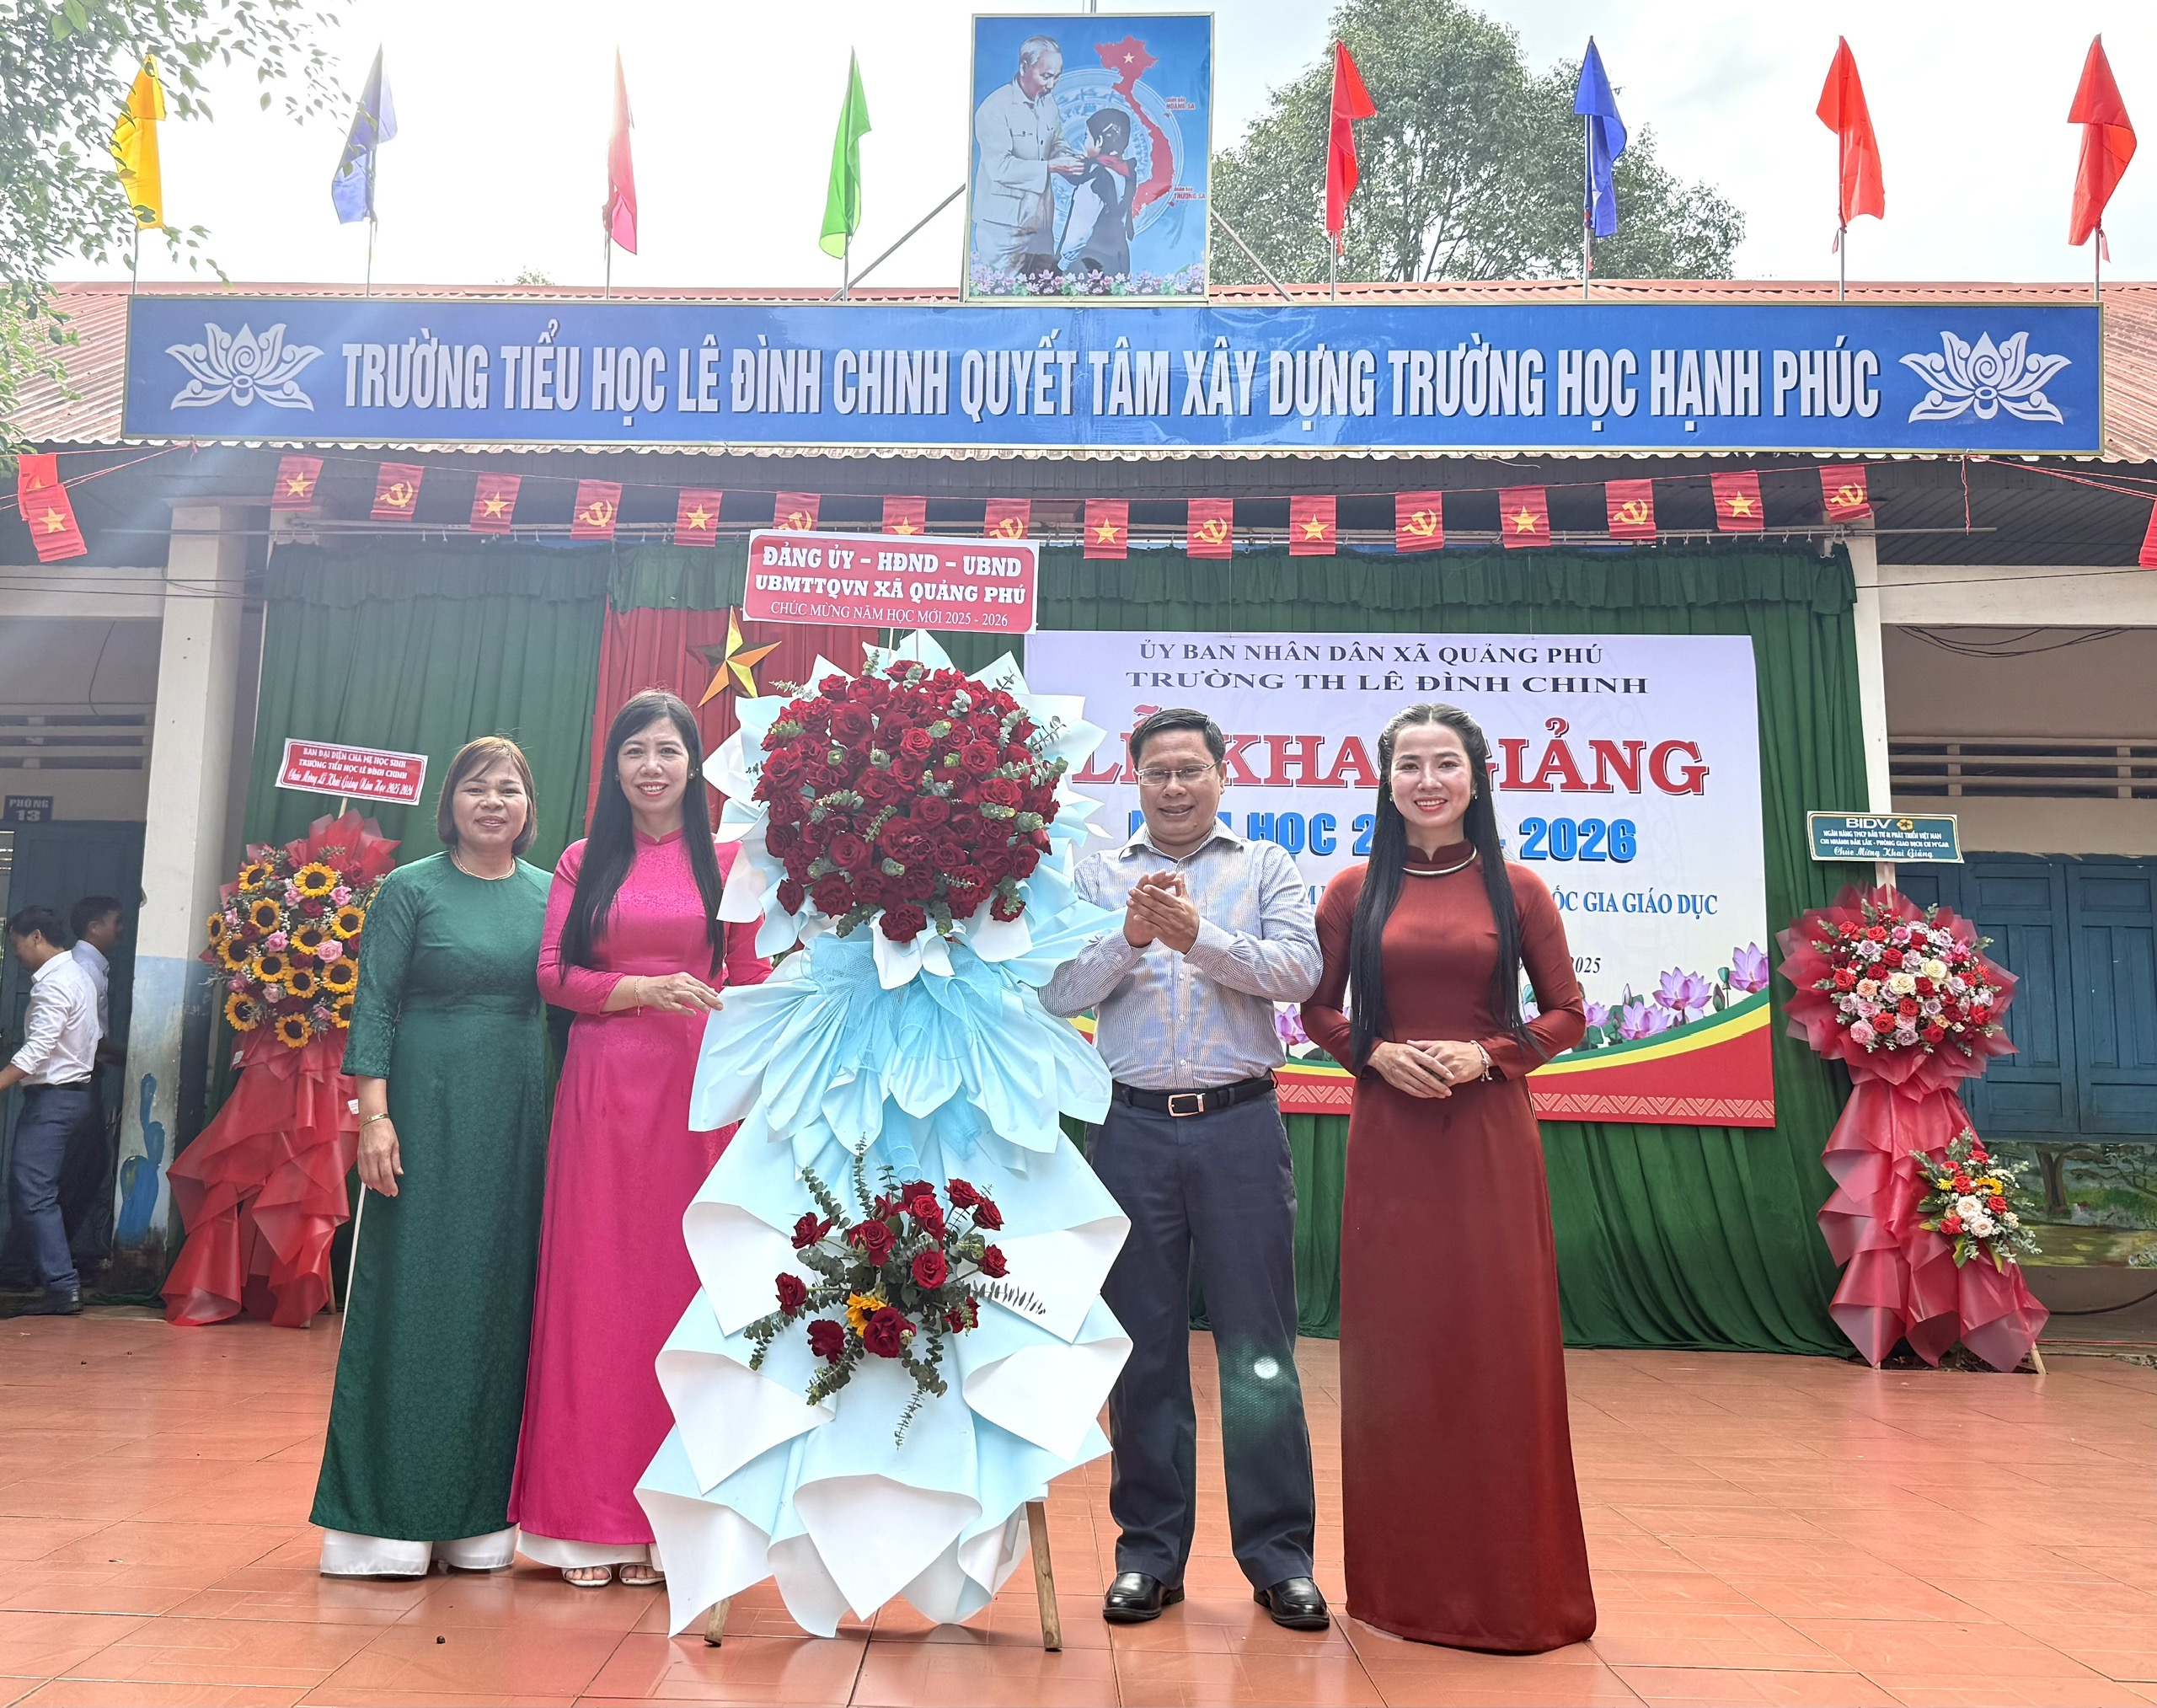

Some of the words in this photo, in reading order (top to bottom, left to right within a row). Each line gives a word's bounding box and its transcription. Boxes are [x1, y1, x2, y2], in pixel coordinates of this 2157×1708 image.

[342, 328, 490, 410] TRƯỜNG
[500, 319, 581, 411] TIỂU
[591, 346, 666, 426] HỌC
[677, 334, 721, 413] LÊ
[731, 335, 822, 414] ĐÌNH
[833, 349, 950, 415] CHINH
[961, 329, 1078, 423] QUYẾT
[1089, 337, 1170, 416] TÂM
[1182, 336, 1255, 417] XÂY
[1268, 343, 1377, 431] DỰNG
[1388, 333, 1545, 417] TRƯỜNG
[1558, 348, 1638, 431] HỌC
[1650, 349, 1760, 431] HẠNH
[1773, 335, 1880, 417] PHÚC
[763, 541, 822, 569] ĐẢNG
[828, 543, 855, 570] ỦY
[877, 552, 939, 573] HĐND
[962, 555, 1022, 577] UBND
[755, 574, 869, 600] UBMTTQVN
[873, 577, 904, 598] XÃ
[909, 579, 978, 604] QUẢNG
[983, 584, 1026, 605] PHÚ
[770, 599, 807, 616] CHÚC
[810, 602, 851, 618] MỪNG
[854, 604, 884, 621] NĂM
[886, 608, 914, 624] HỌC
[918, 608, 942, 624] MỚI
[945, 611, 971, 625] 2025
[982, 613, 1009, 627] 2026
[1139, 639, 1176, 660] ỦY
[1182, 643, 1236, 661] BAN
[1243, 640, 1321, 661] NHÂN
[1328, 640, 1385, 662] DÂN
[1393, 643, 1431, 662] XÃ
[1438, 643, 1538, 667] QUẢNG
[1546, 643, 1603, 664] PHÚ
[1126, 668, 1286, 689] TRƯỜNG
[1295, 673, 1347, 690] TH
[1358, 671, 1405, 691] LÊ
[1414, 671, 1512, 693] ĐÌNH
[1522, 677, 1650, 694] CHINH
[299, 758, 327, 768] TRƯỜNG
[343, 764, 359, 774] HỌC
[359, 765, 367, 774] LÊ
[385, 769, 408, 779] CHINH
[303, 747, 318, 757] BAN
[348, 752, 361, 763] CHA
[363, 755, 373, 765] MẸ
[373, 756, 389, 766] HỌC
[389, 759, 406, 768] SINH
[15, 810, 40, 822] 13
[1845, 817, 1892, 829] BIDV
[1518, 817, 1637, 864] 2026
[1833, 846, 1854, 856] Chúc
[1855, 847, 1881, 858] Mừng
[1882, 847, 1904, 857] Khai
[1906, 848, 1933, 858] Giảng
[1583, 891, 1619, 913] GIA
[1622, 887, 1673, 914] GIÁO
[1677, 893, 1718, 919] DỤC
